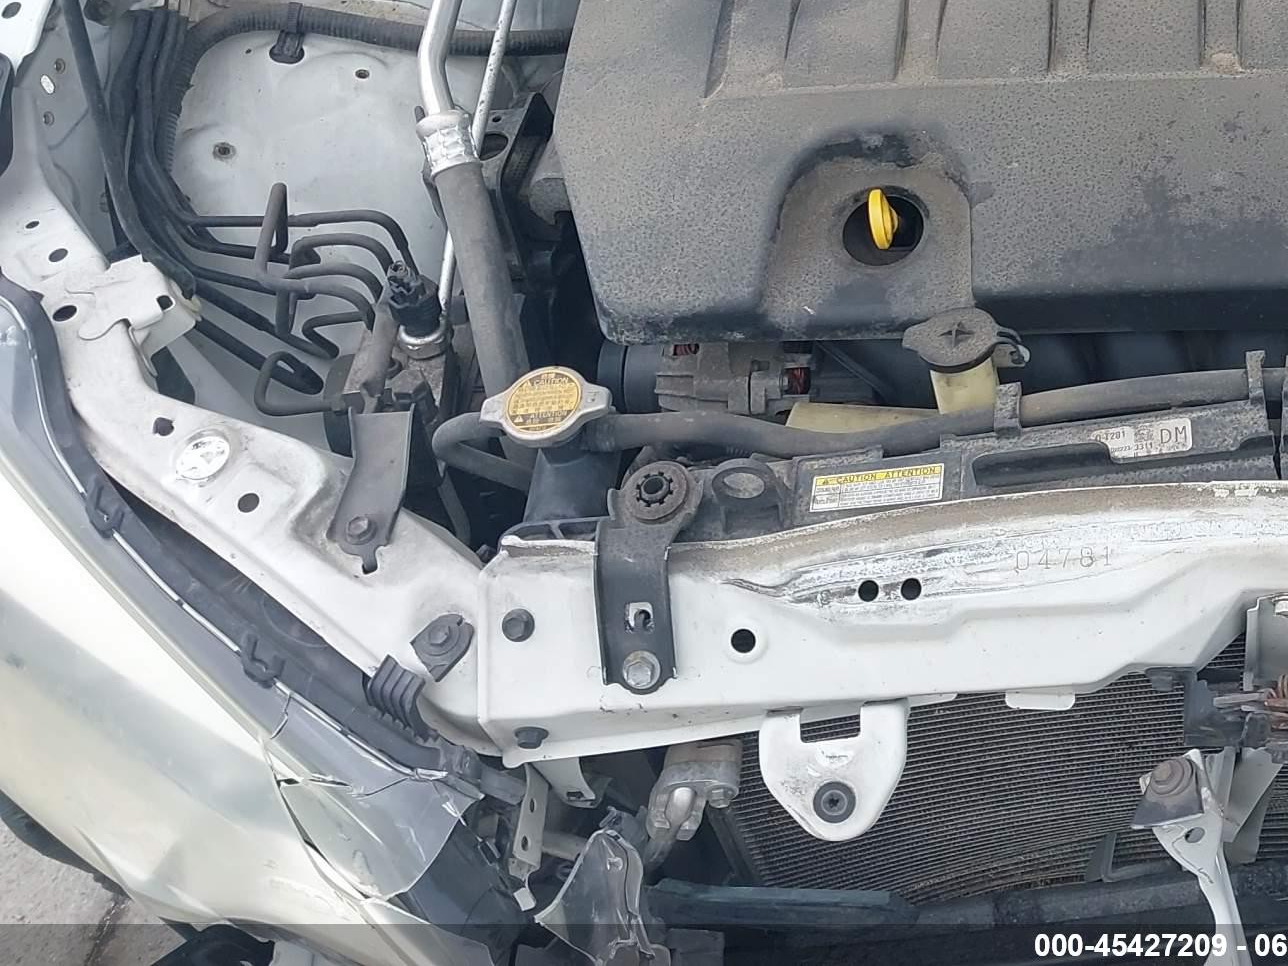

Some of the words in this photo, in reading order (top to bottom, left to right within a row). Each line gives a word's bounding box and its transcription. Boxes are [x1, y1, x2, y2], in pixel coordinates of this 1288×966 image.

[1160, 425, 1188, 444] DM
[836, 473, 878, 485] CAUTION
[885, 466, 937, 480] ATTENTION
[1016, 545, 1112, 571] 04781
